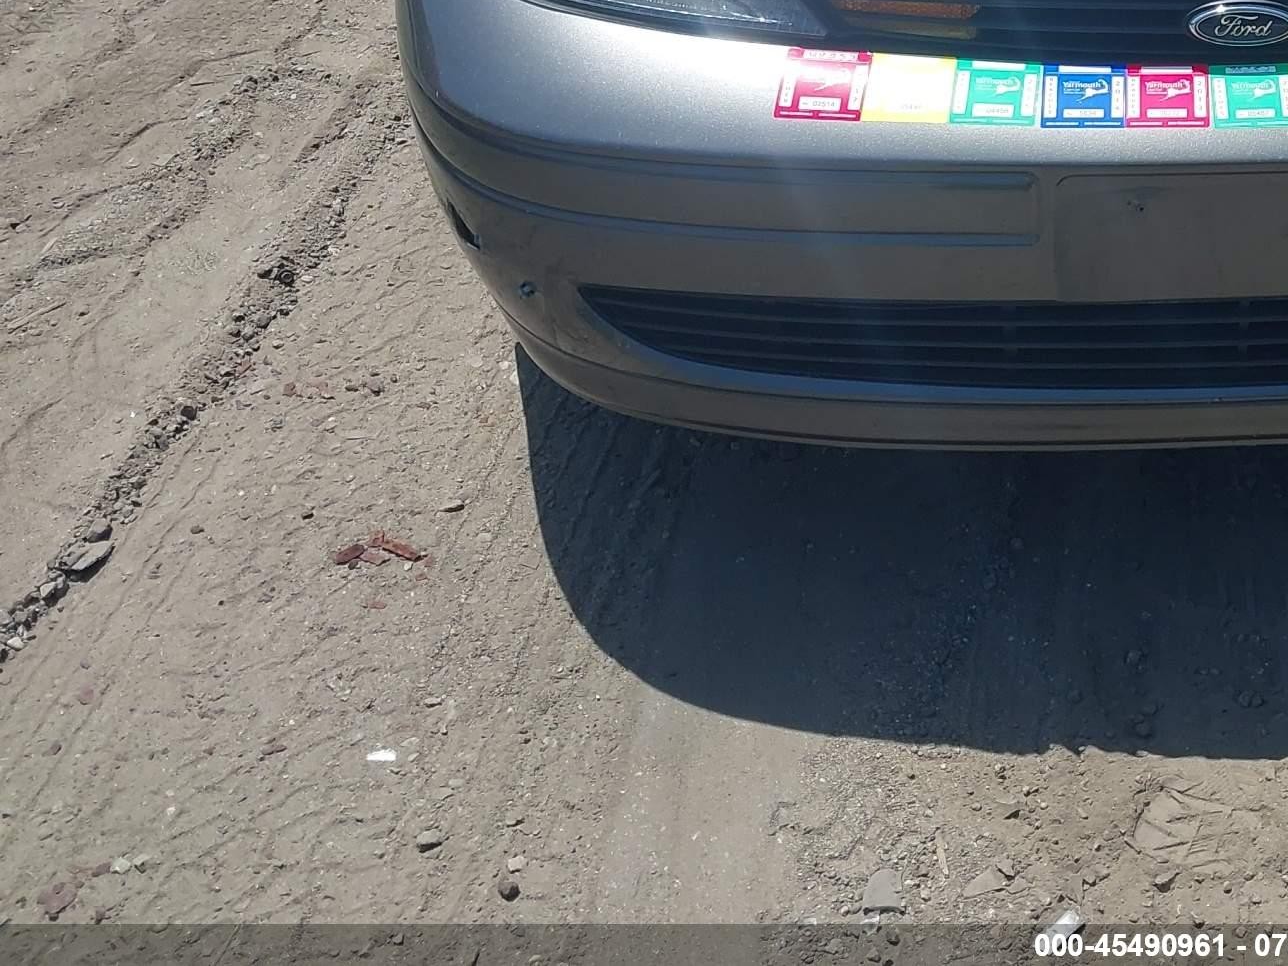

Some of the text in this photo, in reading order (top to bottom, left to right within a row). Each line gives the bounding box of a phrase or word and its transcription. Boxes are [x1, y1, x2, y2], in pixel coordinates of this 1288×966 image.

[1214, 14, 1274, 37] Ford
[1062, 80, 1101, 90] Yarmouth
[1145, 80, 1183, 90] Yarmouth
